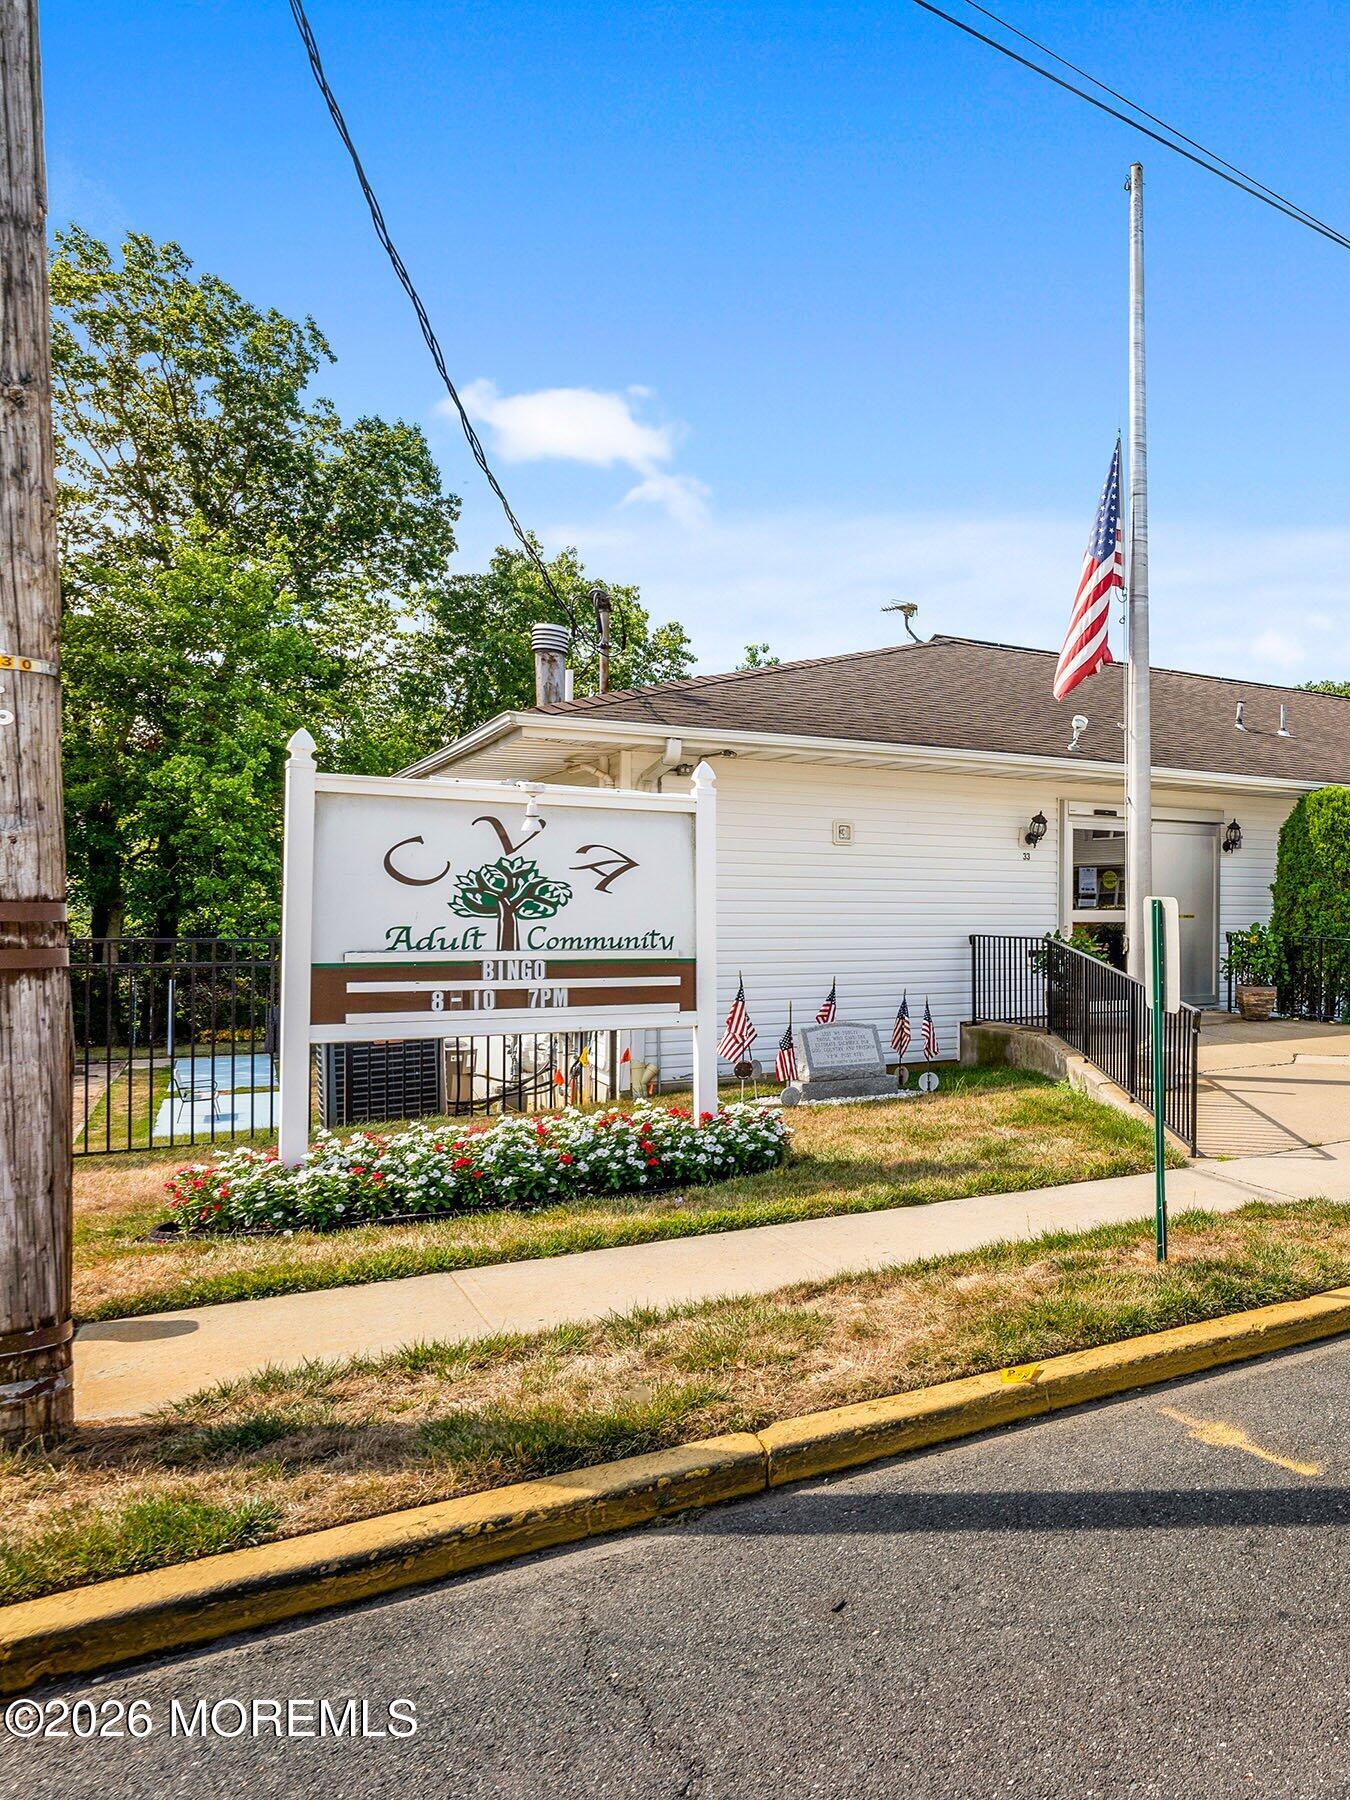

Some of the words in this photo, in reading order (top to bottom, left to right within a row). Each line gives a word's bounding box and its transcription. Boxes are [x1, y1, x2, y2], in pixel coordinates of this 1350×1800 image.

[1022, 852, 1031, 861] 33
[385, 925, 487, 951] Adult
[527, 925, 675, 951] Community
[482, 959, 546, 981] BINGO
[528, 988, 569, 1009] 7PM
